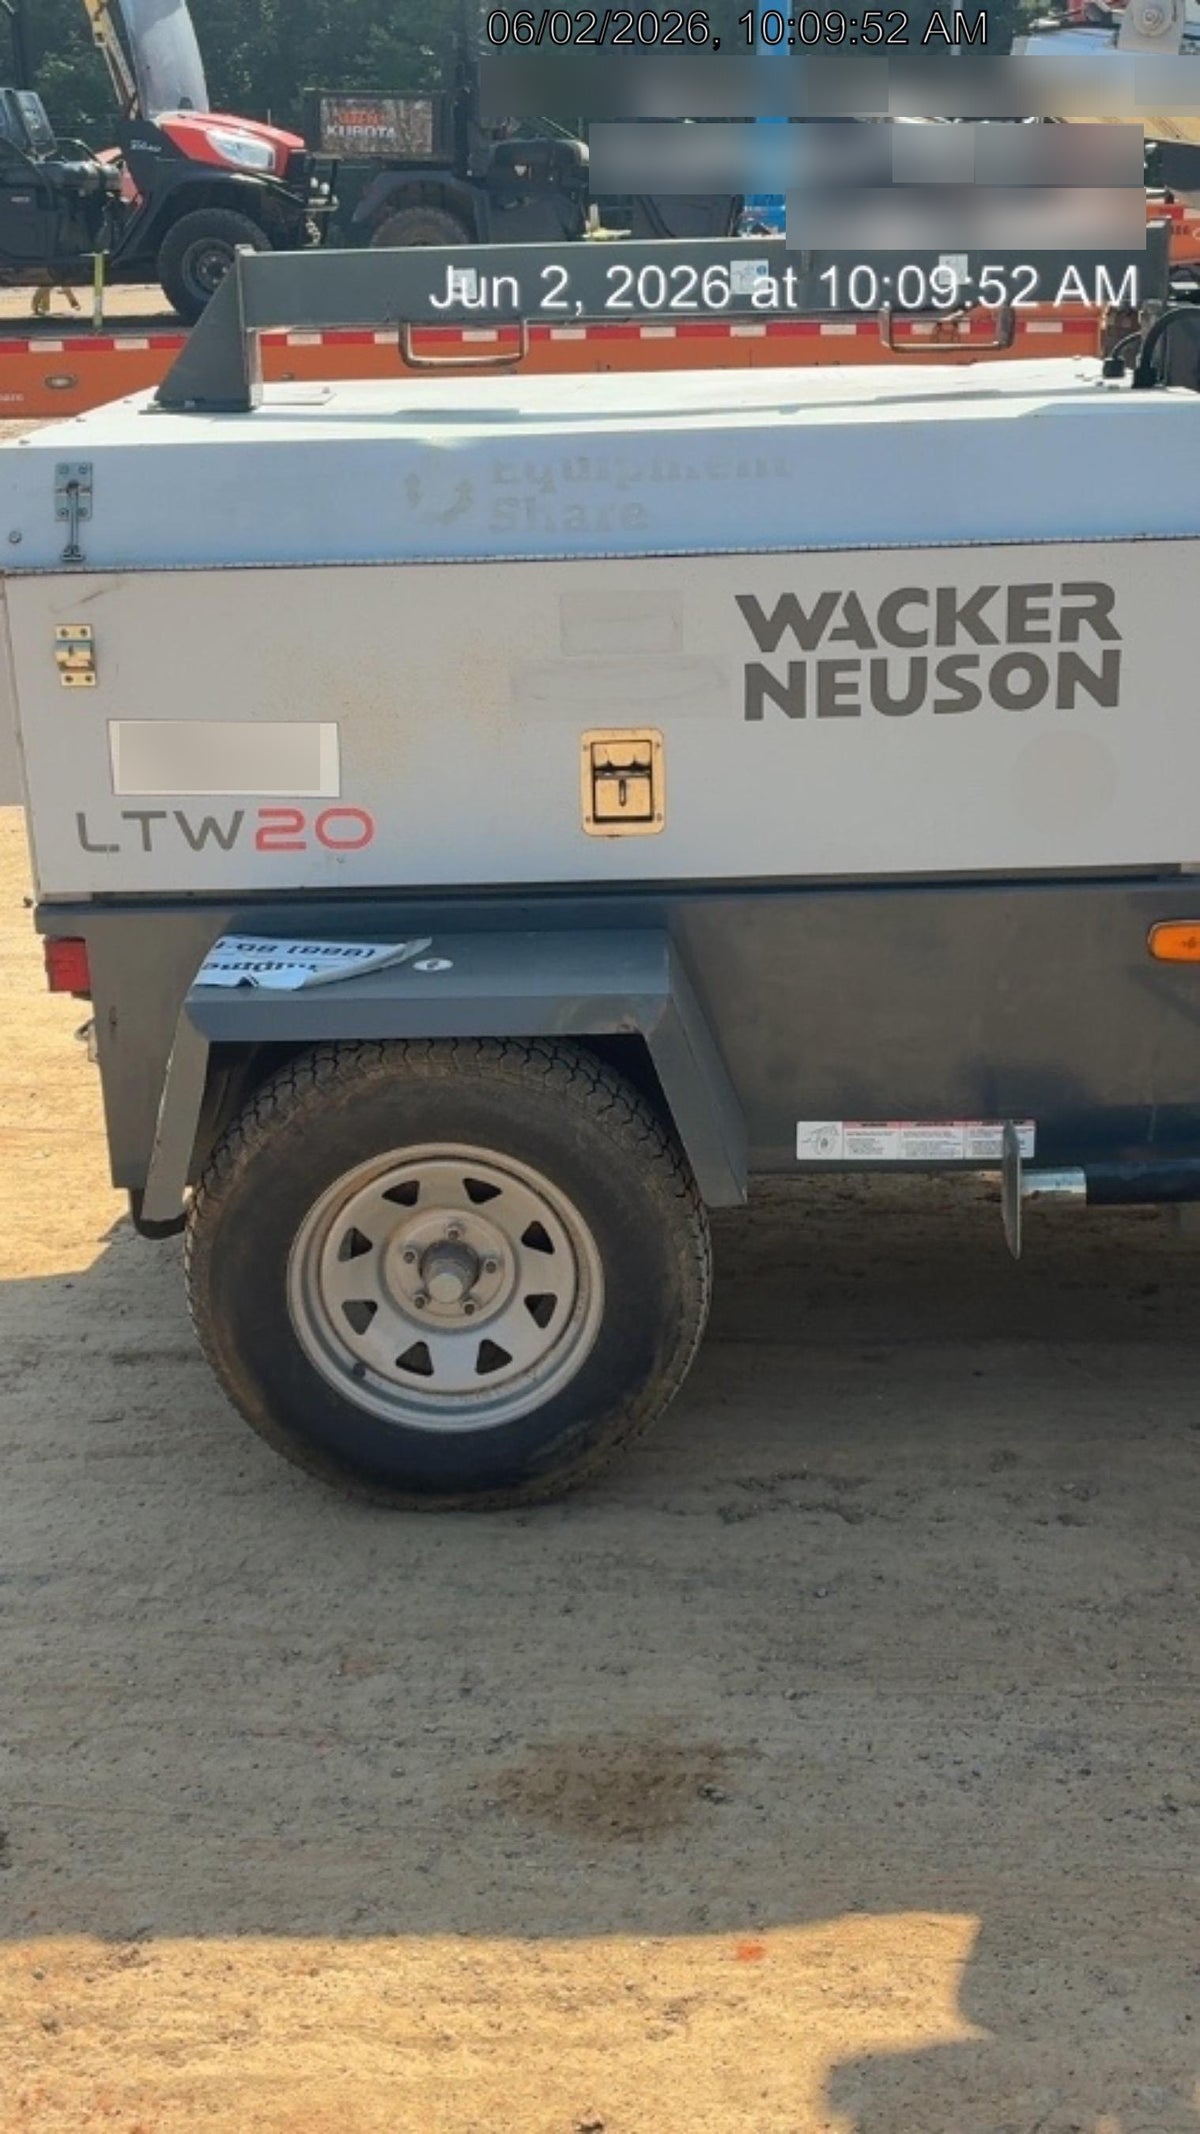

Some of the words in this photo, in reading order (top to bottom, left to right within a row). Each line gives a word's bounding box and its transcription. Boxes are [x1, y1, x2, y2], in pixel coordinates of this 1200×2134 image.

[734, 581, 1123, 653] WACKER
[744, 649, 1122, 721] NEUSON
[76, 807, 375, 853] LTW20
